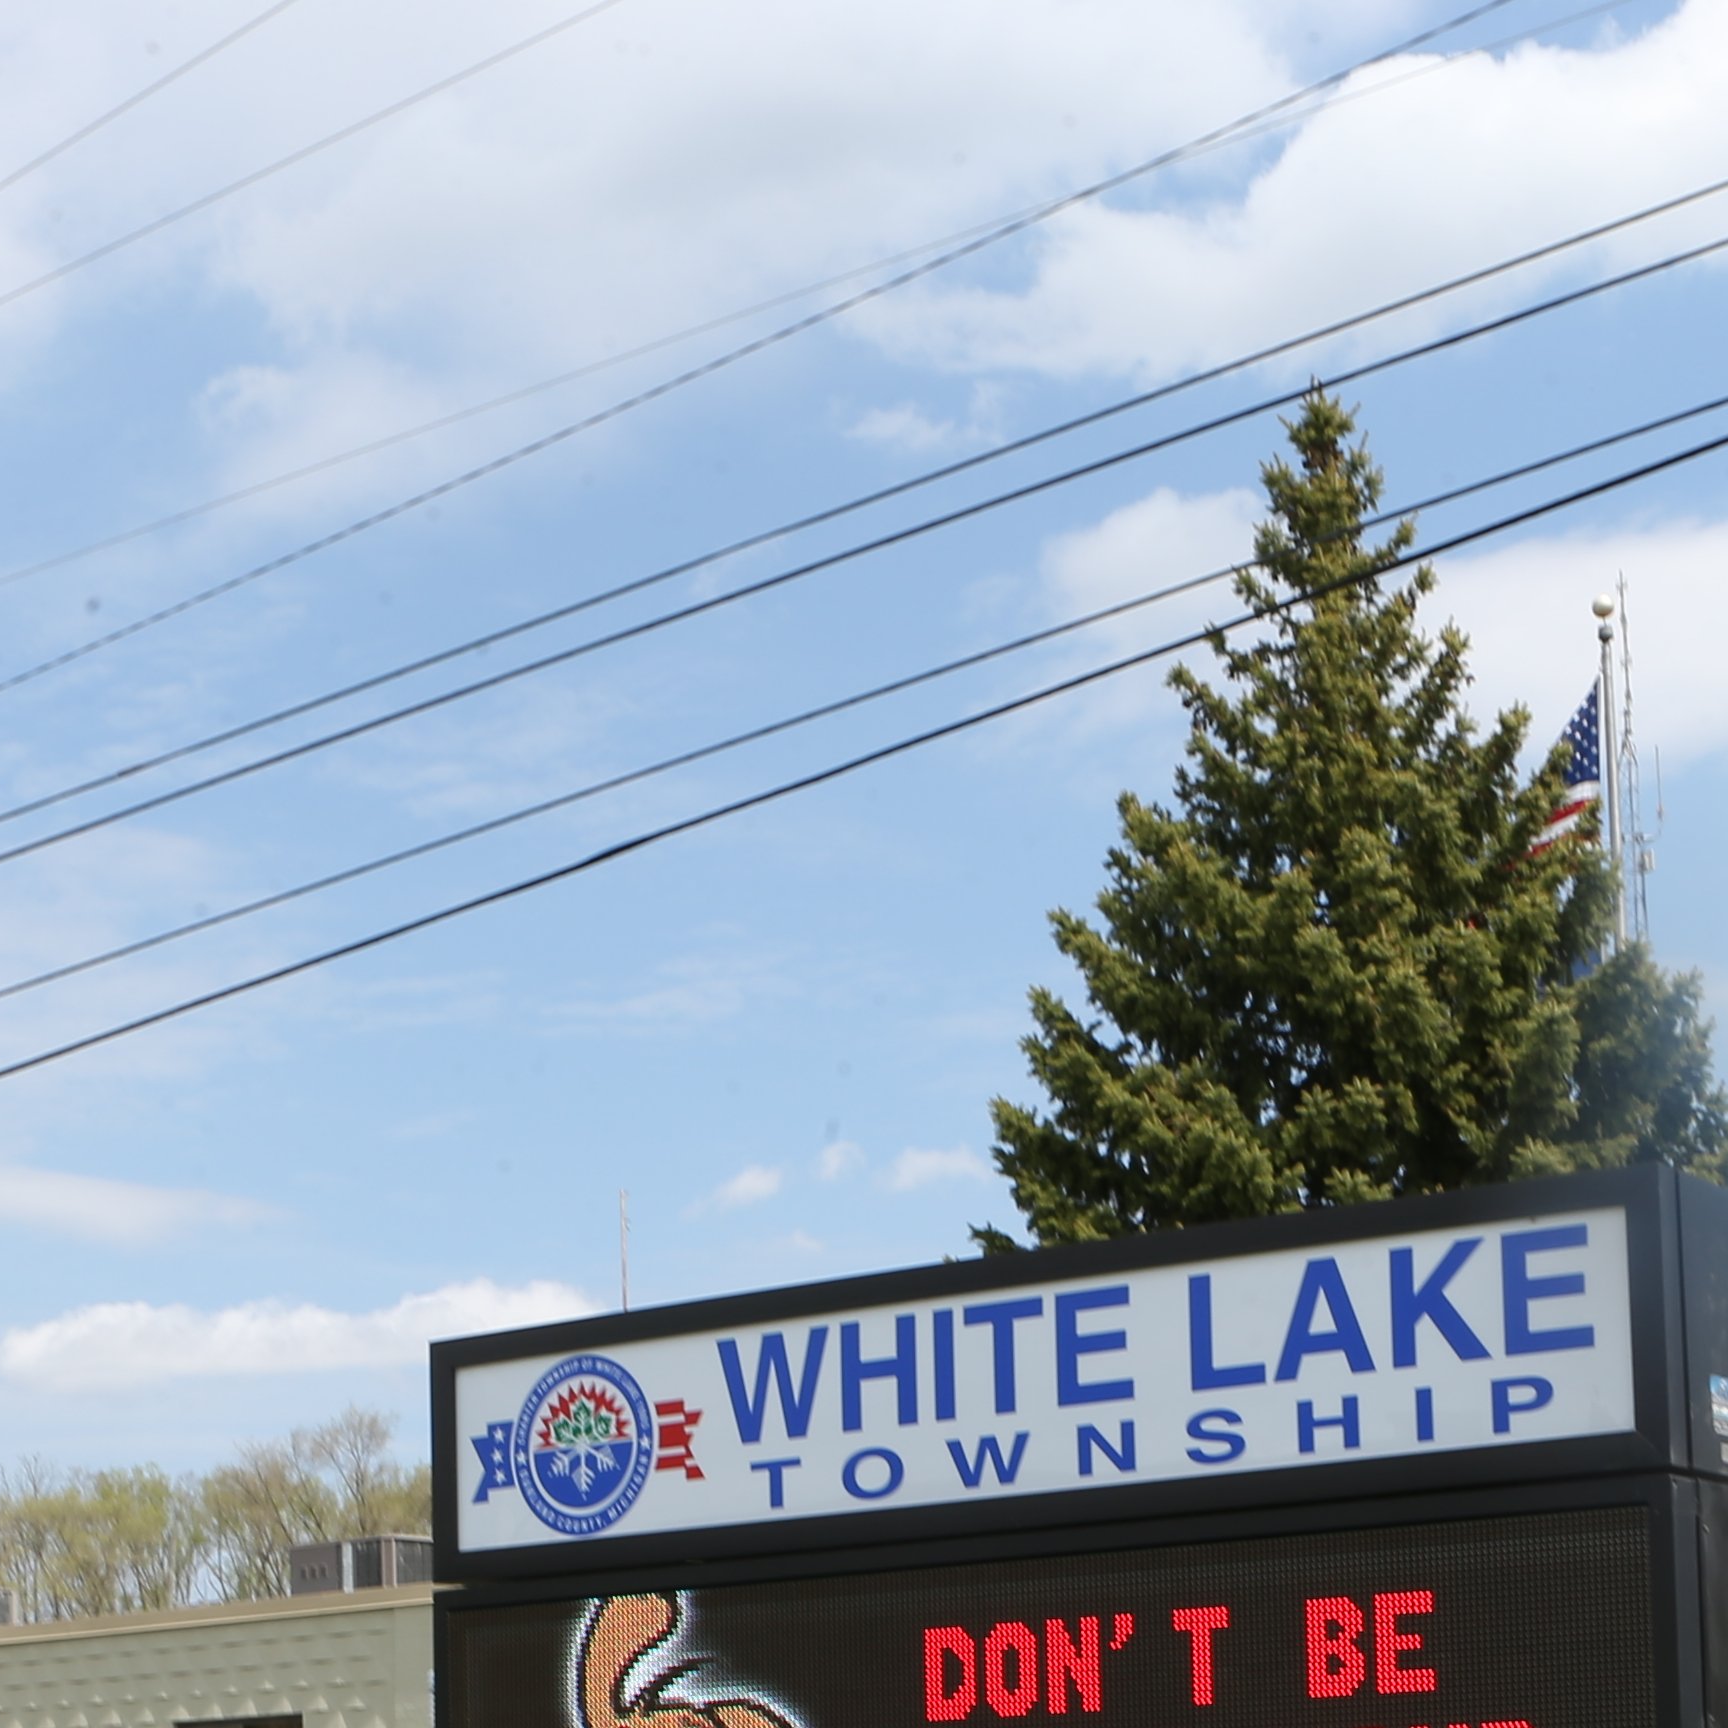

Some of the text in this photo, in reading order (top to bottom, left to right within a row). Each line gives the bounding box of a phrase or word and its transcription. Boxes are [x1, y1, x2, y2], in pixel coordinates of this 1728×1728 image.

[718, 1224, 1595, 1444] WHITE LAKE
[608, 1454, 649, 1521] MICHIGAN
[750, 1375, 1555, 1508] TOWNSHIP
[923, 1589, 1438, 1723] DON'T BE
